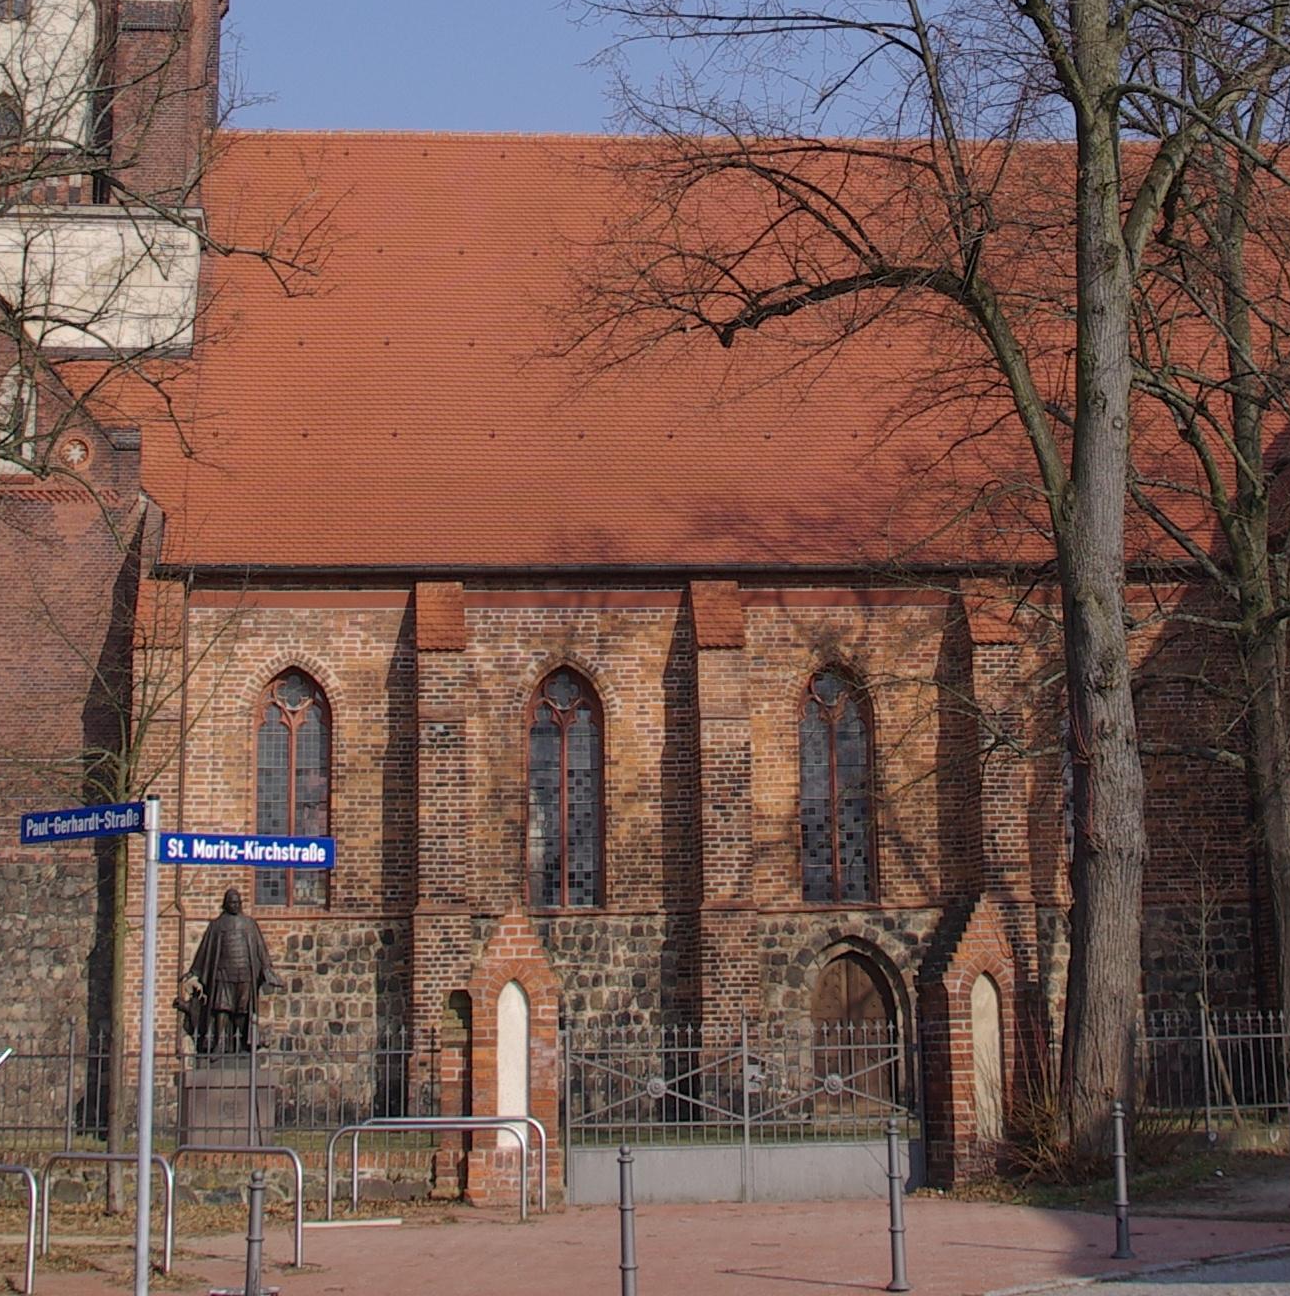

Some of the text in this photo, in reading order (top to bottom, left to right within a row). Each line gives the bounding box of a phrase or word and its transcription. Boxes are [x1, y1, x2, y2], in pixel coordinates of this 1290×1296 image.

[25, 809, 140, 838] Paul-Gerhardt-Straße
[167, 838, 326, 863] St. Moritz-Kirchstraße
